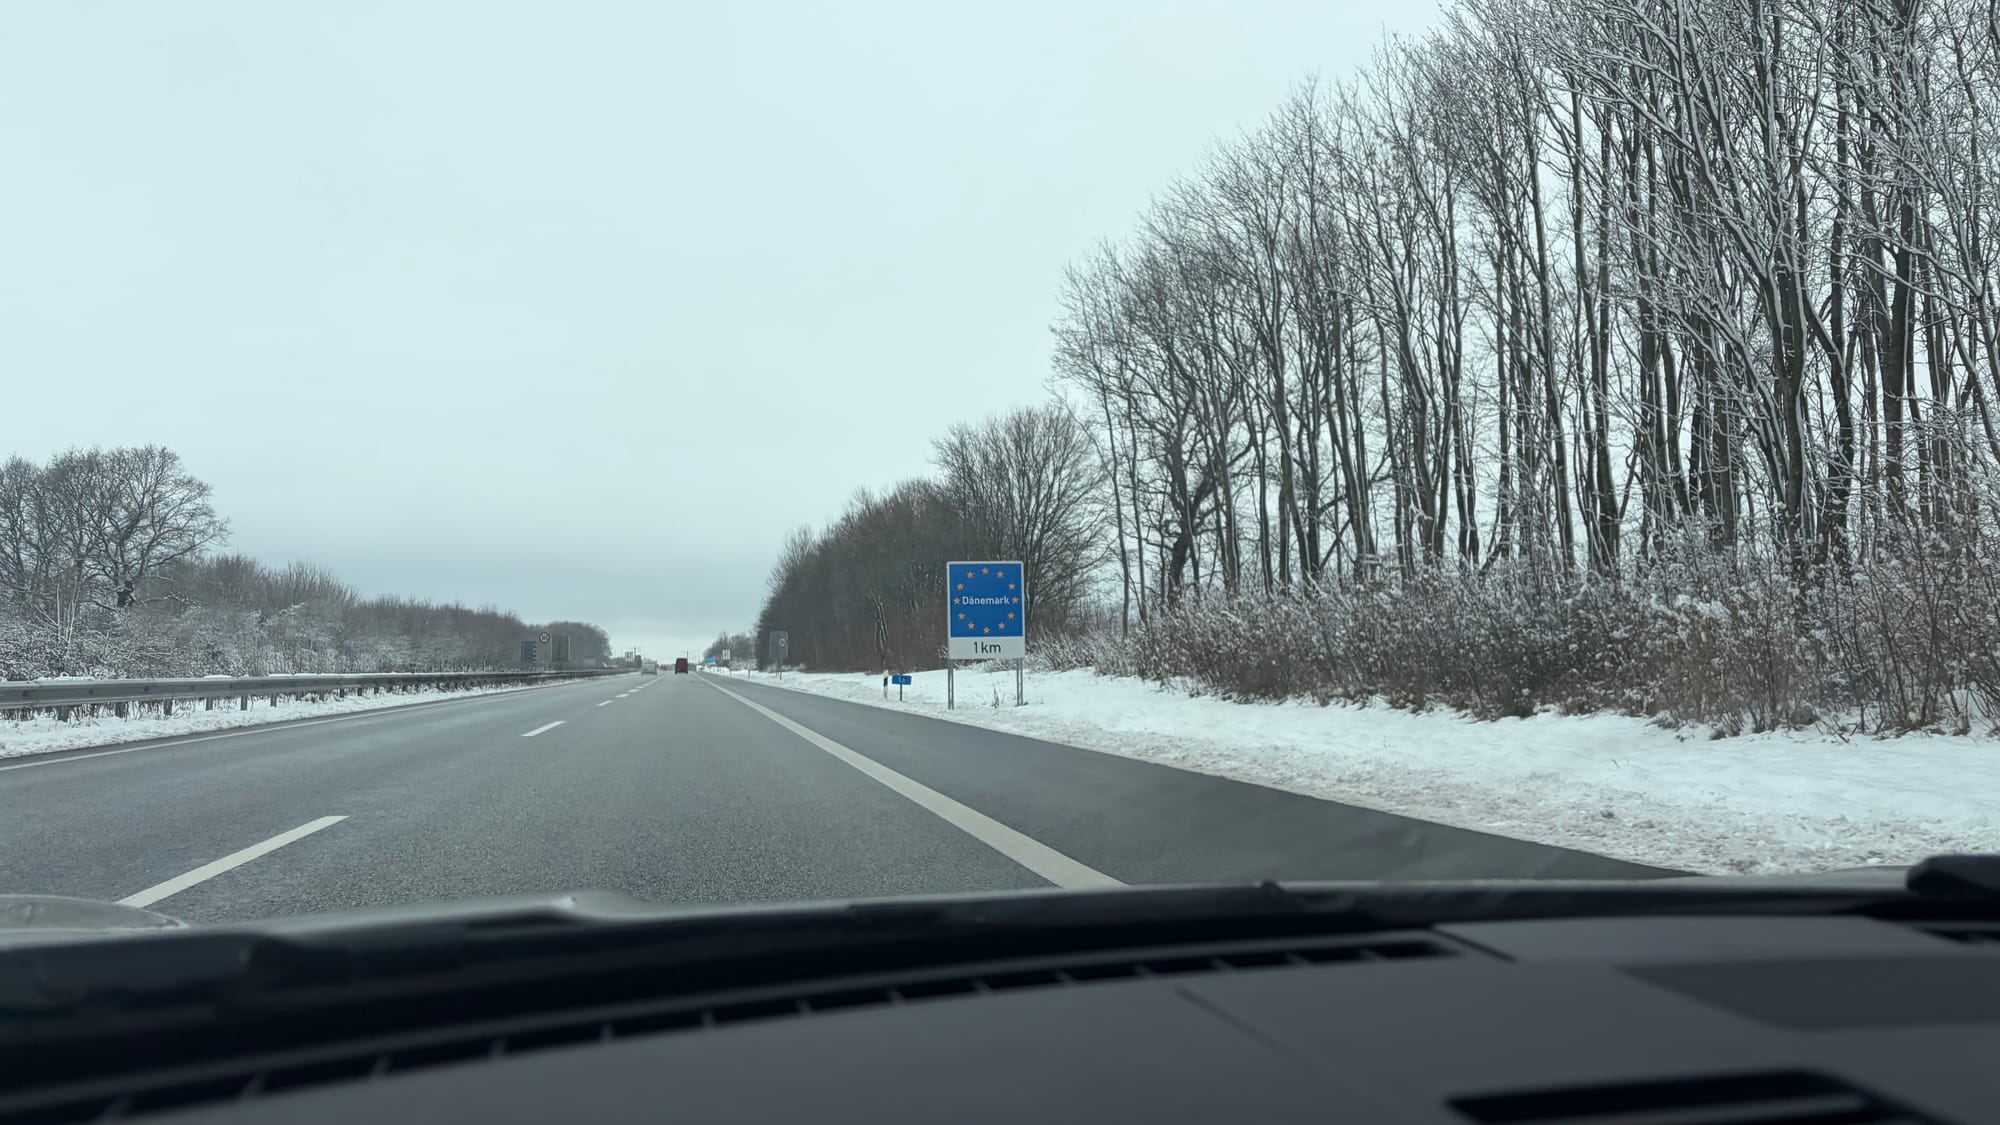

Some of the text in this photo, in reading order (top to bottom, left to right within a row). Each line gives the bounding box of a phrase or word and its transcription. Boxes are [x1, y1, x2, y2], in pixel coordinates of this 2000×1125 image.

[962, 596, 1010, 605] Dänemark
[974, 641, 1001, 653] 1 km
